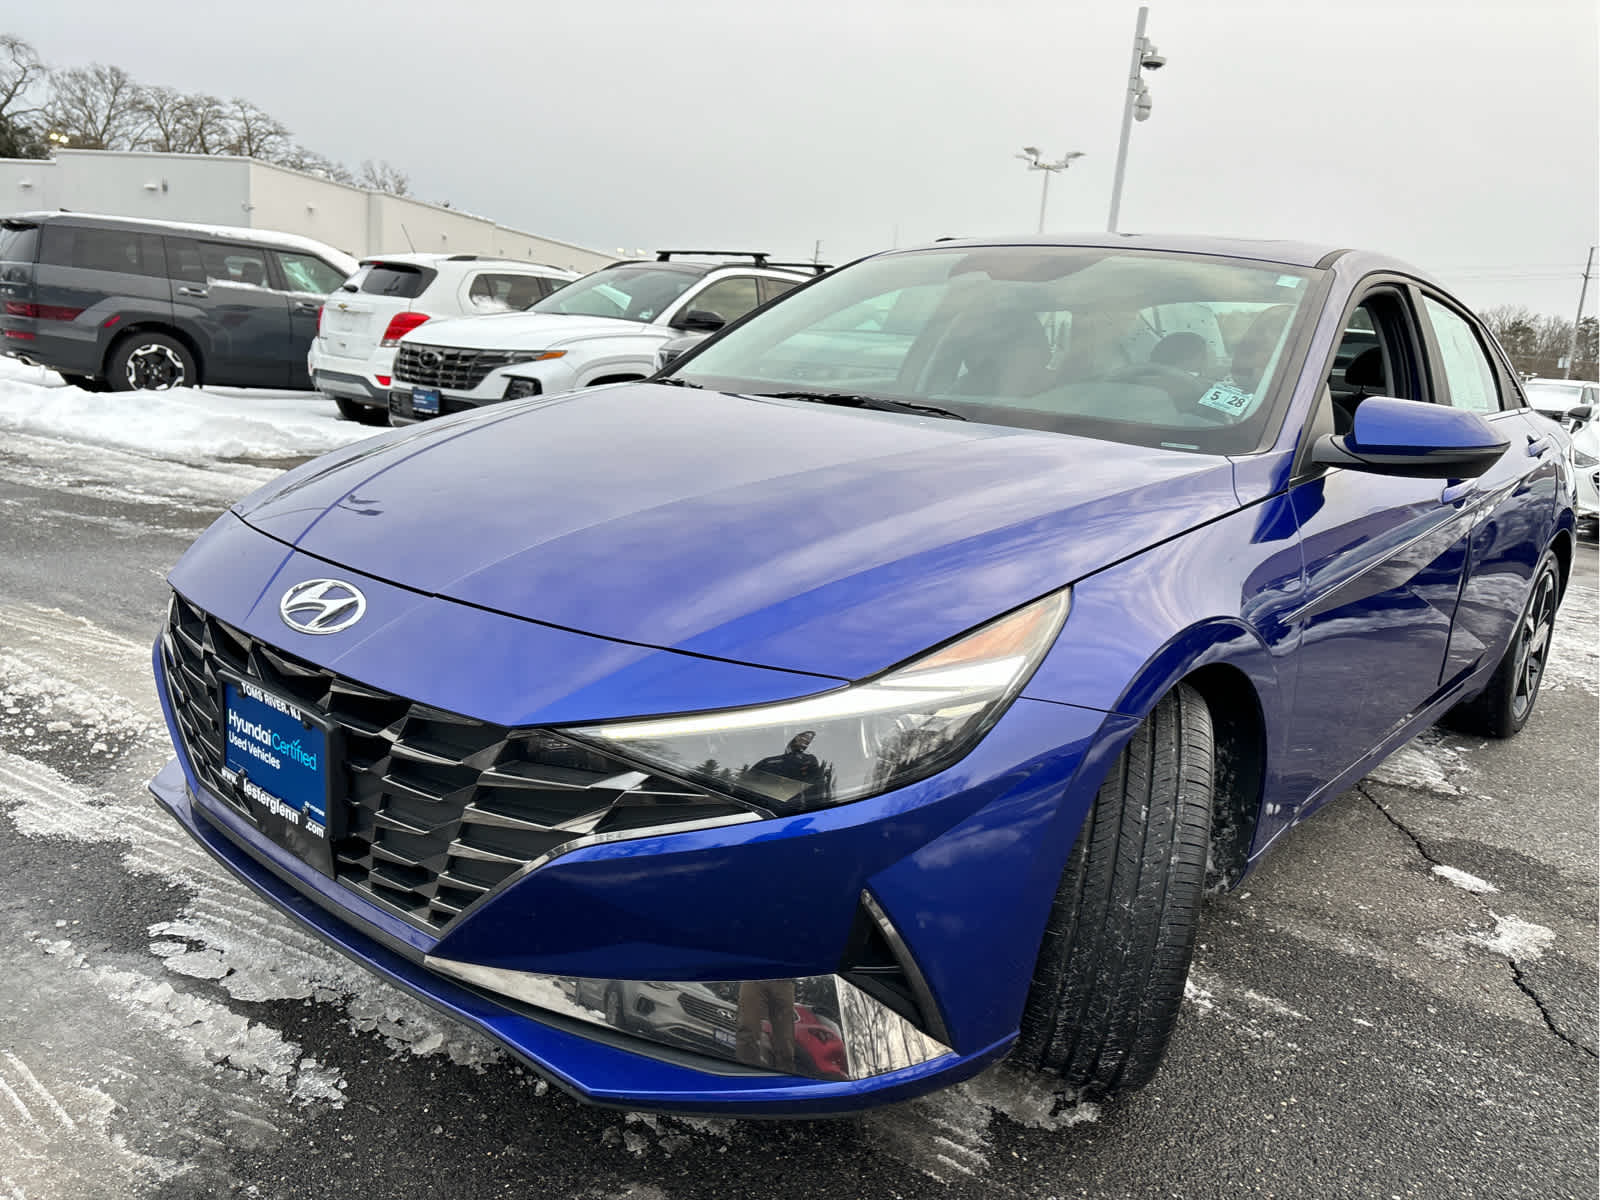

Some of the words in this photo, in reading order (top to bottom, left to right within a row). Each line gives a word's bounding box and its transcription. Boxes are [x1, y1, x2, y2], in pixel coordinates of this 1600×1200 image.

[1210, 391, 1221, 401] 5
[1226, 395, 1246, 408] 28
[241, 681, 263, 702] TOMS
[289, 705, 302, 721] NJ
[228, 708, 272, 747] Hyundai
[271, 732, 317, 771] Certified
[228, 729, 247, 751] Used
[247, 740, 281, 770] Vehicles
[243, 778, 299, 825] lesterglenn
[305, 821, 325, 839] .com
